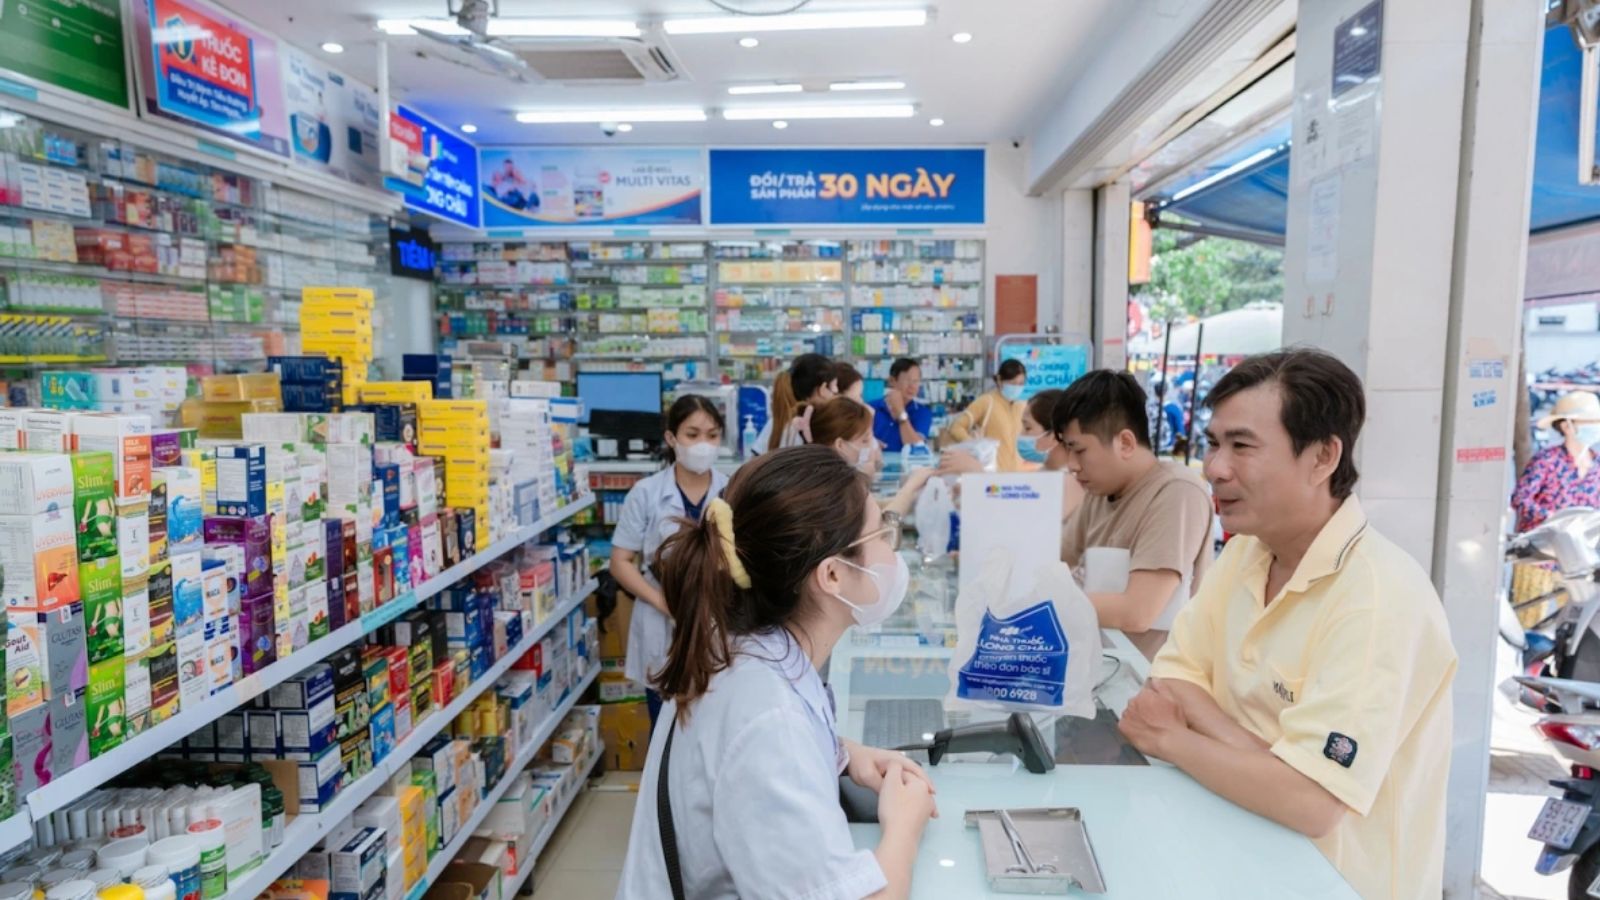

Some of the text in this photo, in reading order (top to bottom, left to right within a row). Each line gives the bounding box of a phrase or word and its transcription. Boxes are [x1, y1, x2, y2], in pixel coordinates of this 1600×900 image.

[616, 175, 691, 187] MULTI VITAS
[819, 167, 956, 198] 30 NGÀY
[1001, 491, 1020, 499] LONG
[88, 577, 112, 594] Slim
[5, 634, 26, 648] Gout
[980, 639, 1054, 651] LONG CHÂU
[1013, 635, 1045, 645] THUỐC
[15, 643, 29, 655] Aid
[1018, 653, 1047, 664] thuốc
[974, 660, 998, 671] theo
[1020, 664, 1041, 674] bác
[91, 678, 115, 696] Slim
[1009, 688, 1037, 700] 6928
